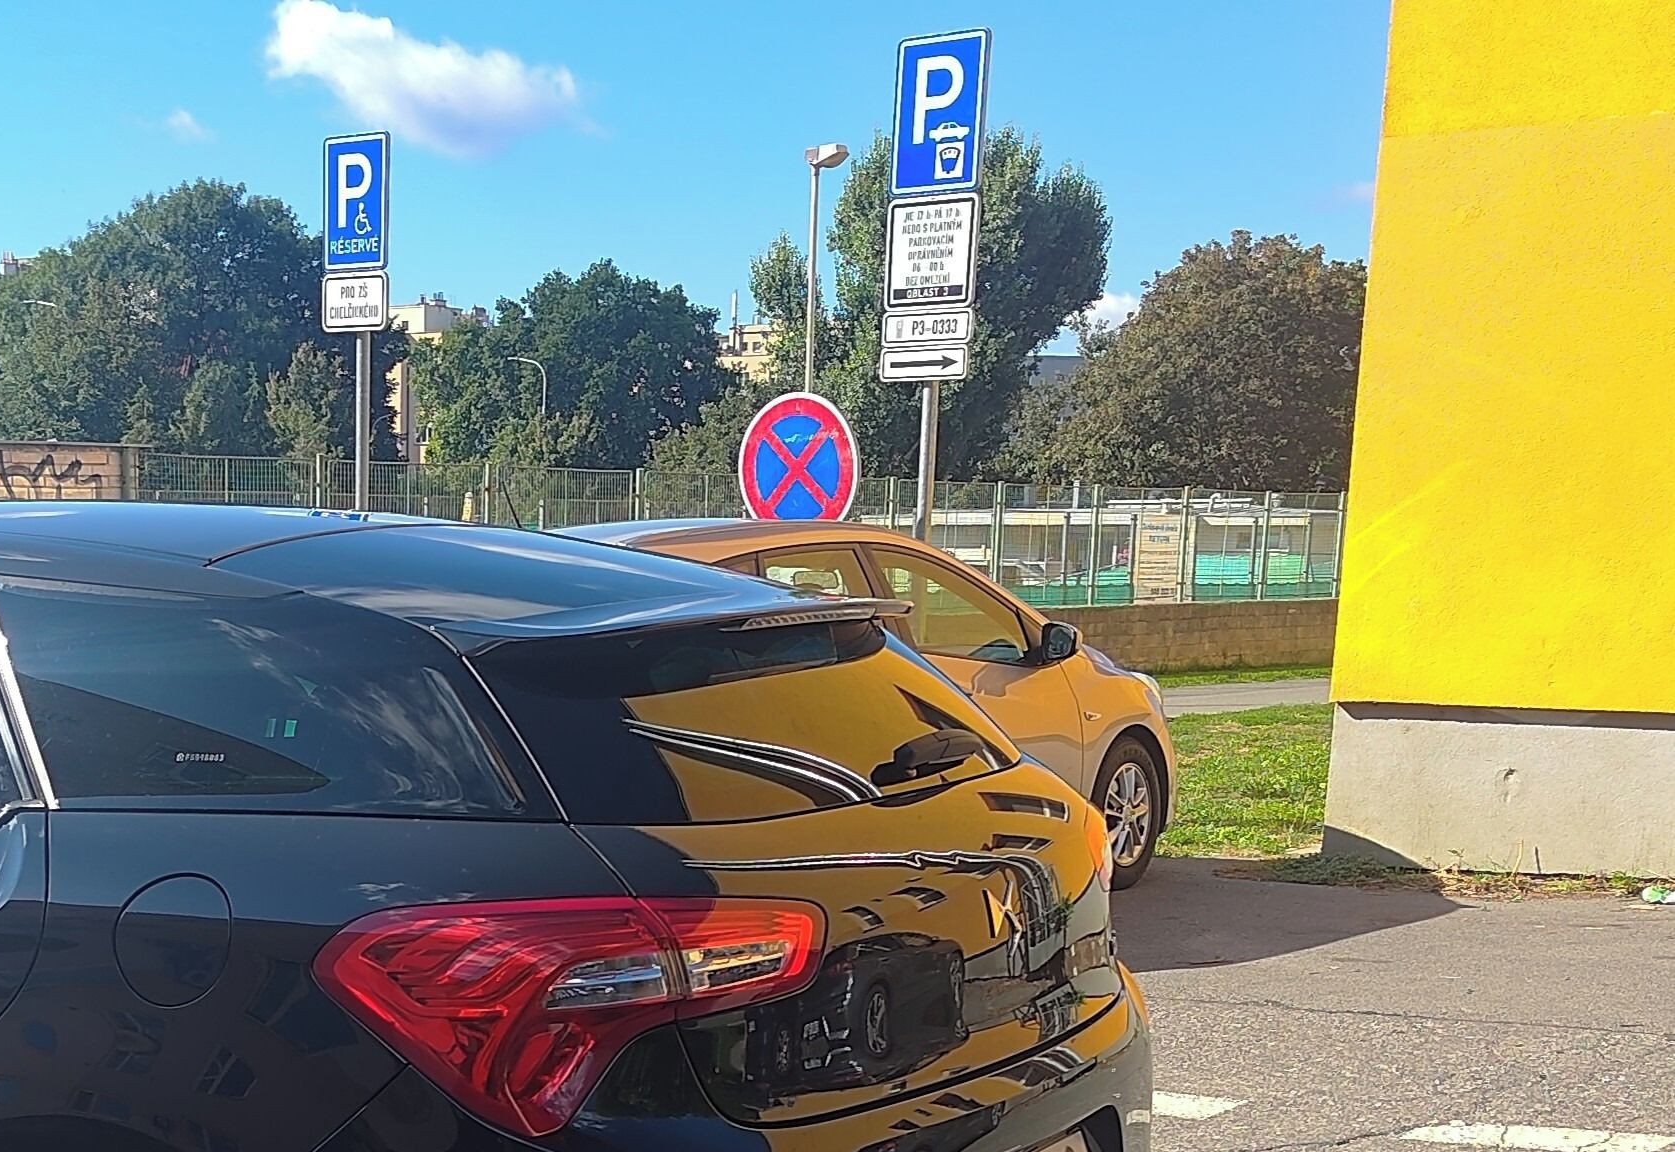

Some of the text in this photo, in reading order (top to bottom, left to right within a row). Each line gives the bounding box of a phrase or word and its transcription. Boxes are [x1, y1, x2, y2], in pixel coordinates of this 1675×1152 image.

[912, 55, 964, 145] P
[337, 152, 372, 229] P
[923, 223, 928, 233] S
[930, 218, 962, 233] PLATNÝM
[330, 234, 379, 255] RÉSERVÉ
[909, 234, 954, 247] PARKOVACÍM
[908, 247, 953, 260] OPRÁVNĚNÍM
[341, 282, 368, 299] PRO ZŠ
[907, 287, 949, 299] OBLAST 3
[912, 319, 958, 336] P3-0333
